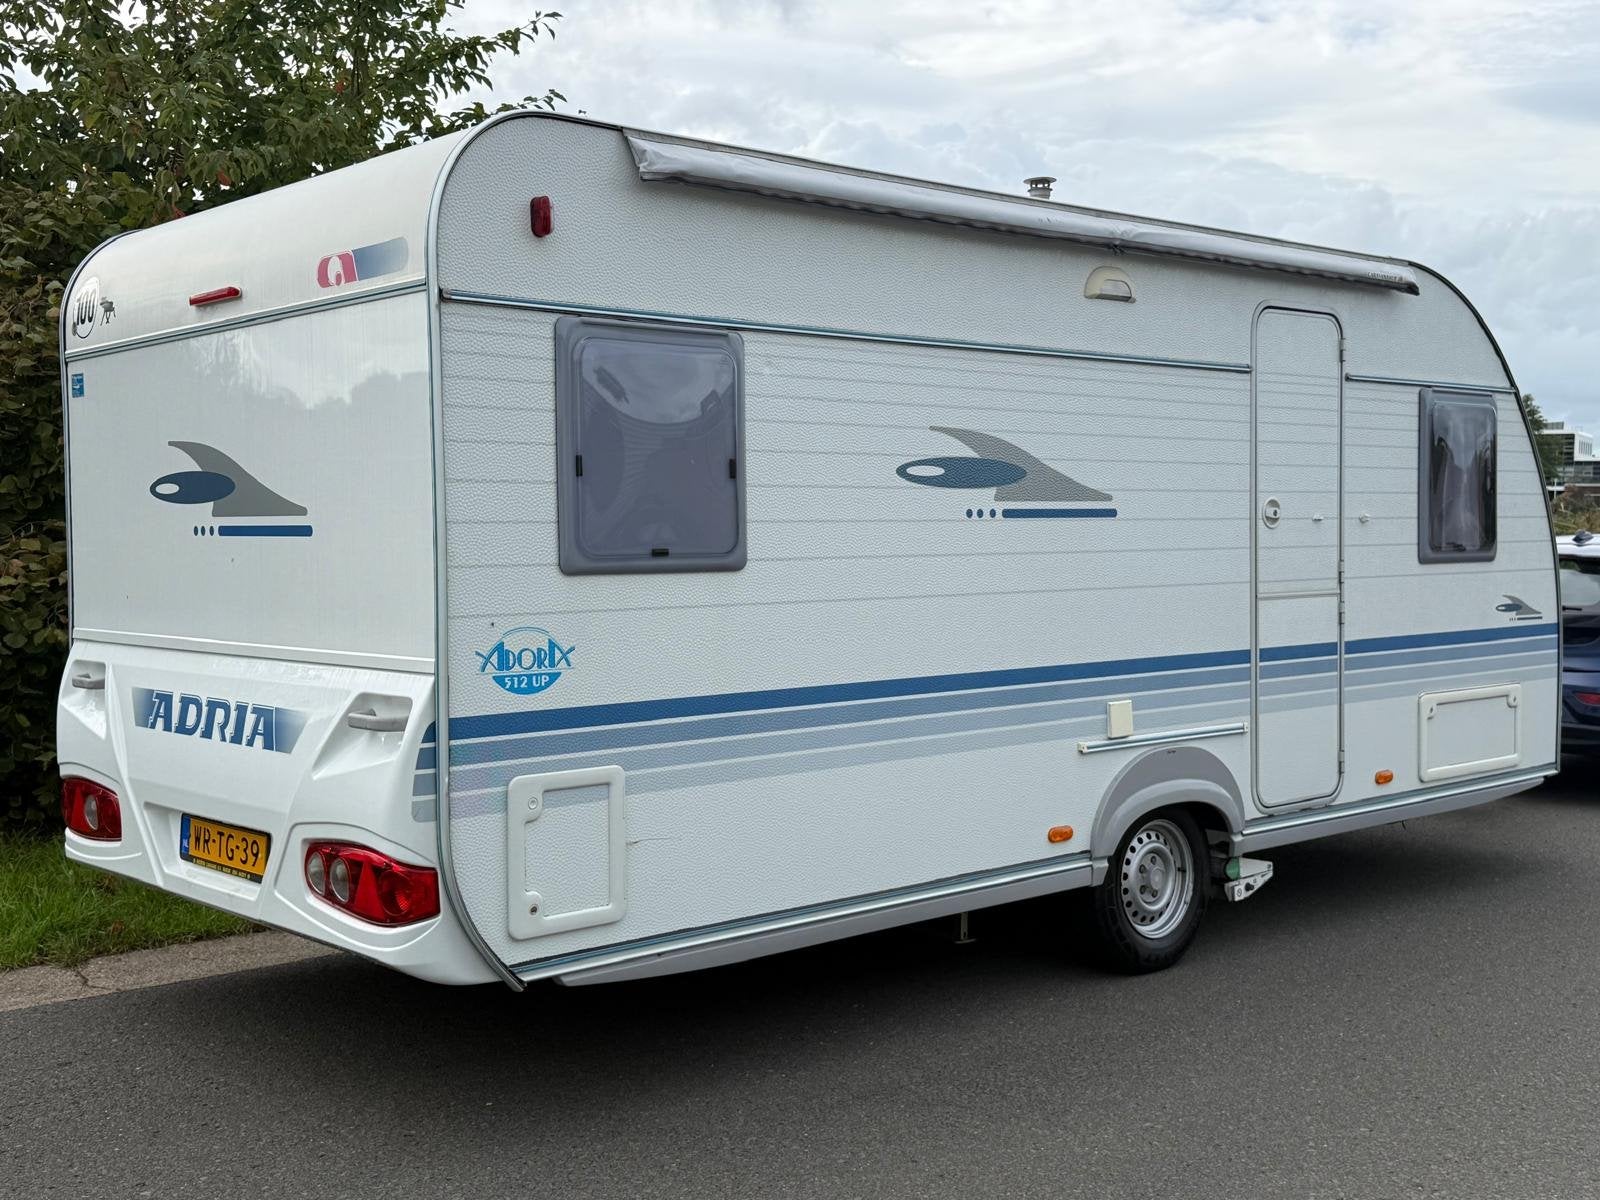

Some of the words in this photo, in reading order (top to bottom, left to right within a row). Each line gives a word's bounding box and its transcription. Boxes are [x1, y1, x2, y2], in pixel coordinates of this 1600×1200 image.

[76, 290, 97, 326] 100
[504, 676, 528, 689] 512
[532, 675, 550, 688] UP
[148, 690, 276, 751] ADRIA
[194, 825, 260, 867] WR-TG-39
